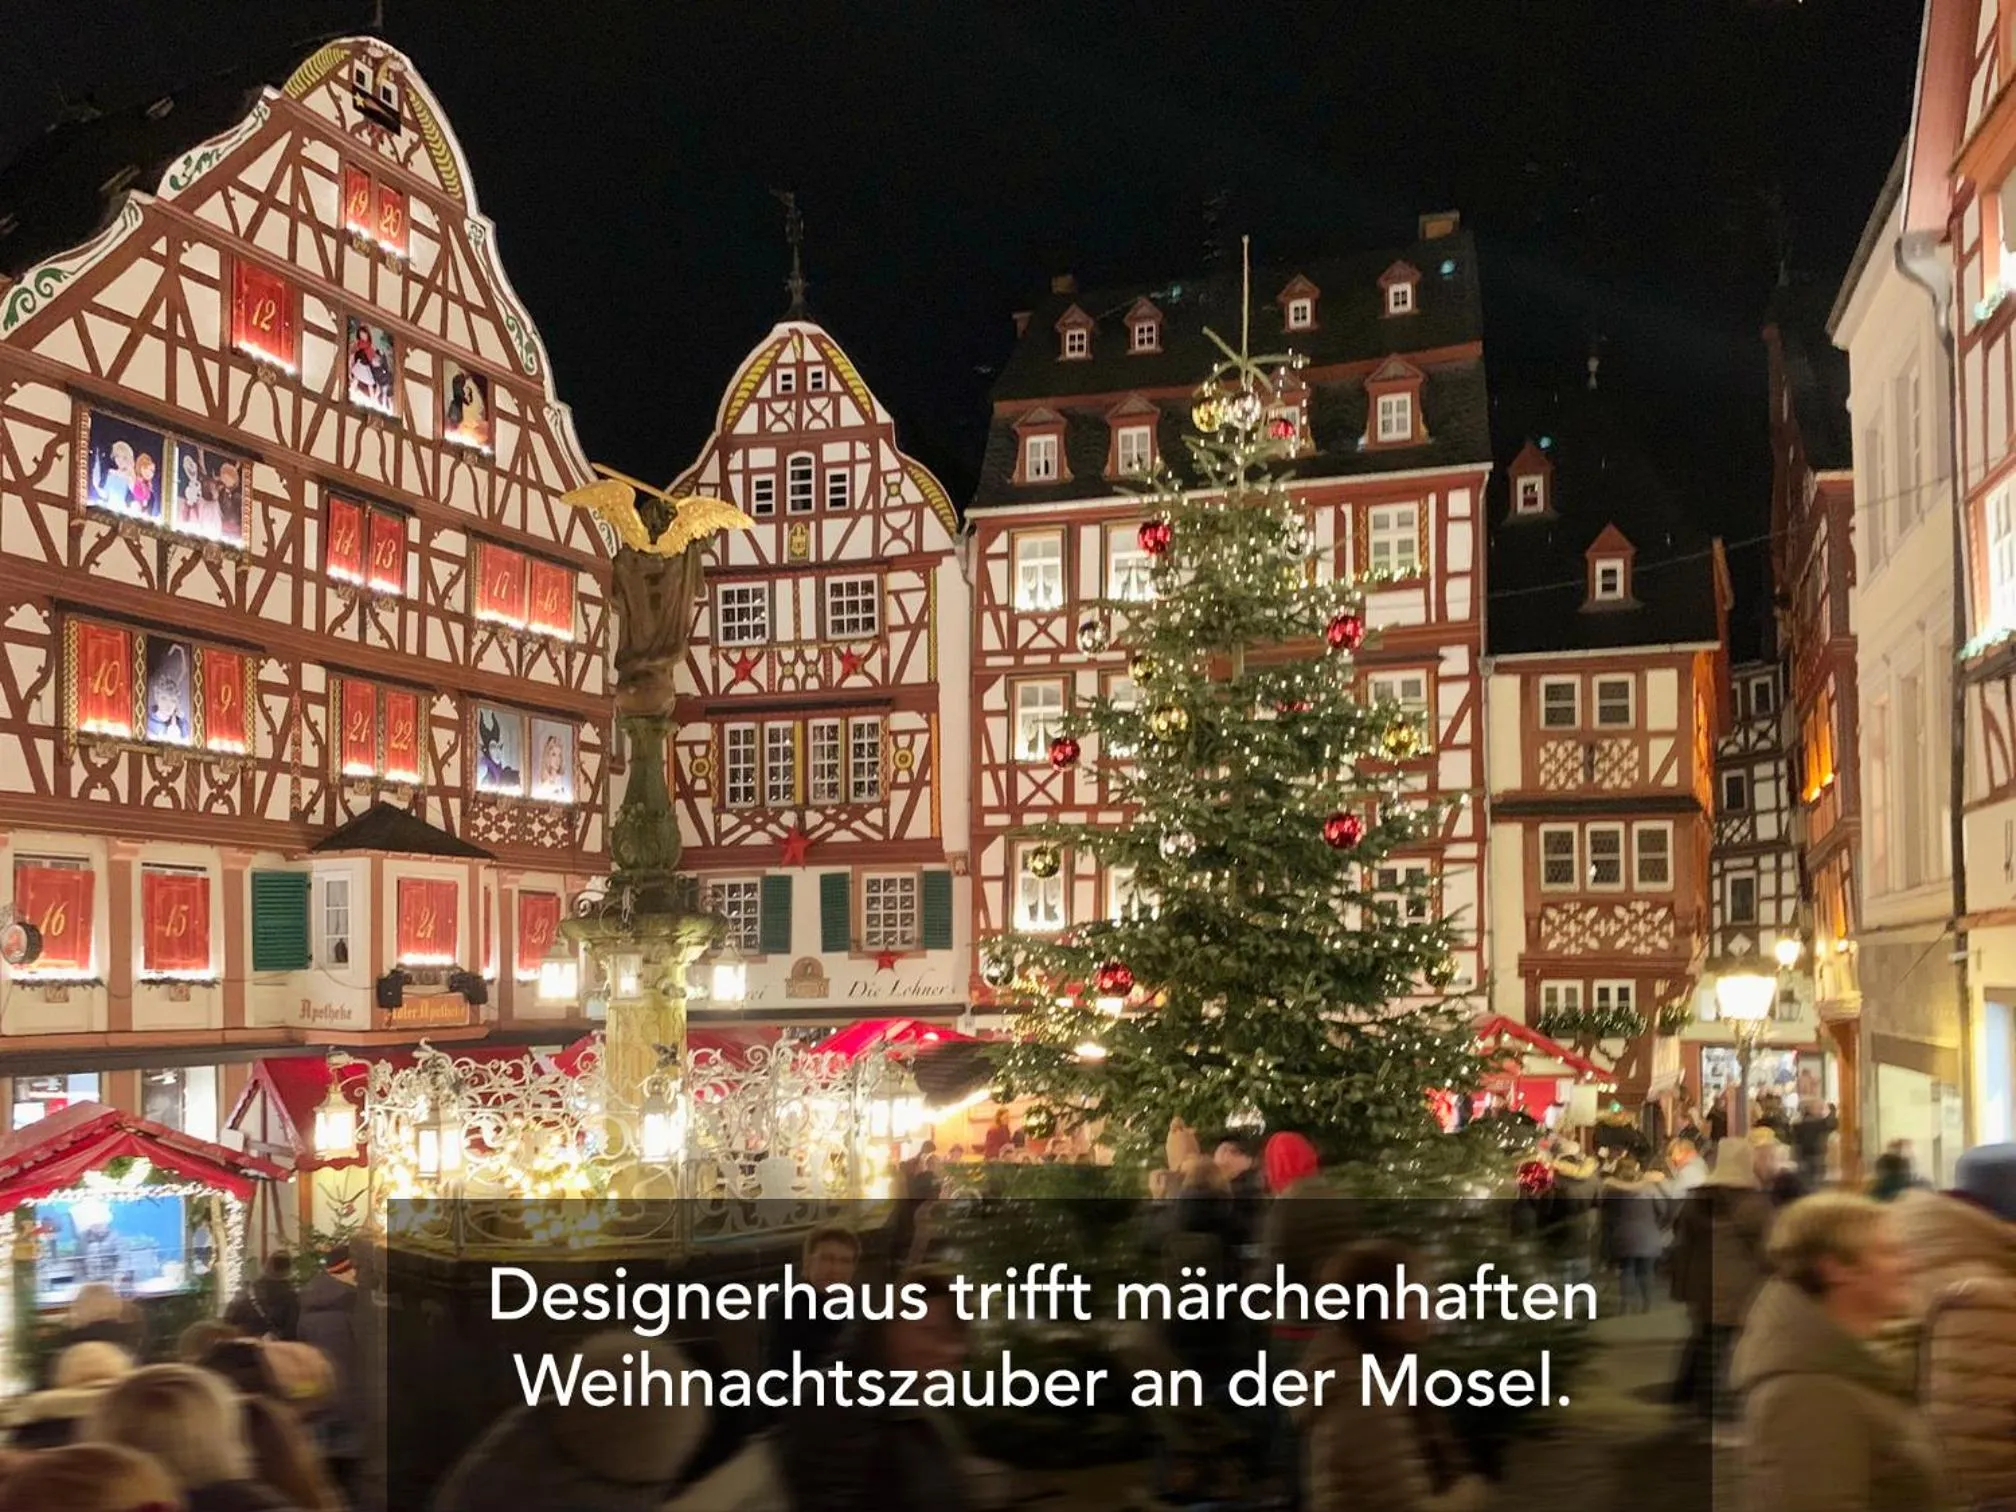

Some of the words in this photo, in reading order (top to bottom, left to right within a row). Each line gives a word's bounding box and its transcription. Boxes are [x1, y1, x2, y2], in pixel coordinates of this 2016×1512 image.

[348, 188, 369, 217] 19
[380, 203, 402, 237] 20
[252, 297, 276, 331] 12
[335, 526, 355, 556] 14
[374, 538, 396, 570] 13
[493, 570, 511, 600] 17
[93, 660, 121, 697] 10
[220, 684, 233, 715] 9
[348, 709, 371, 743] 21
[390, 718, 413, 750] 22
[40, 900, 69, 936] 16
[164, 904, 190, 937] 15
[416, 906, 437, 939] 24
[530, 917, 549, 945] 23
[847, 980, 881, 997] Die
[298, 998, 353, 1024] Apotheke
